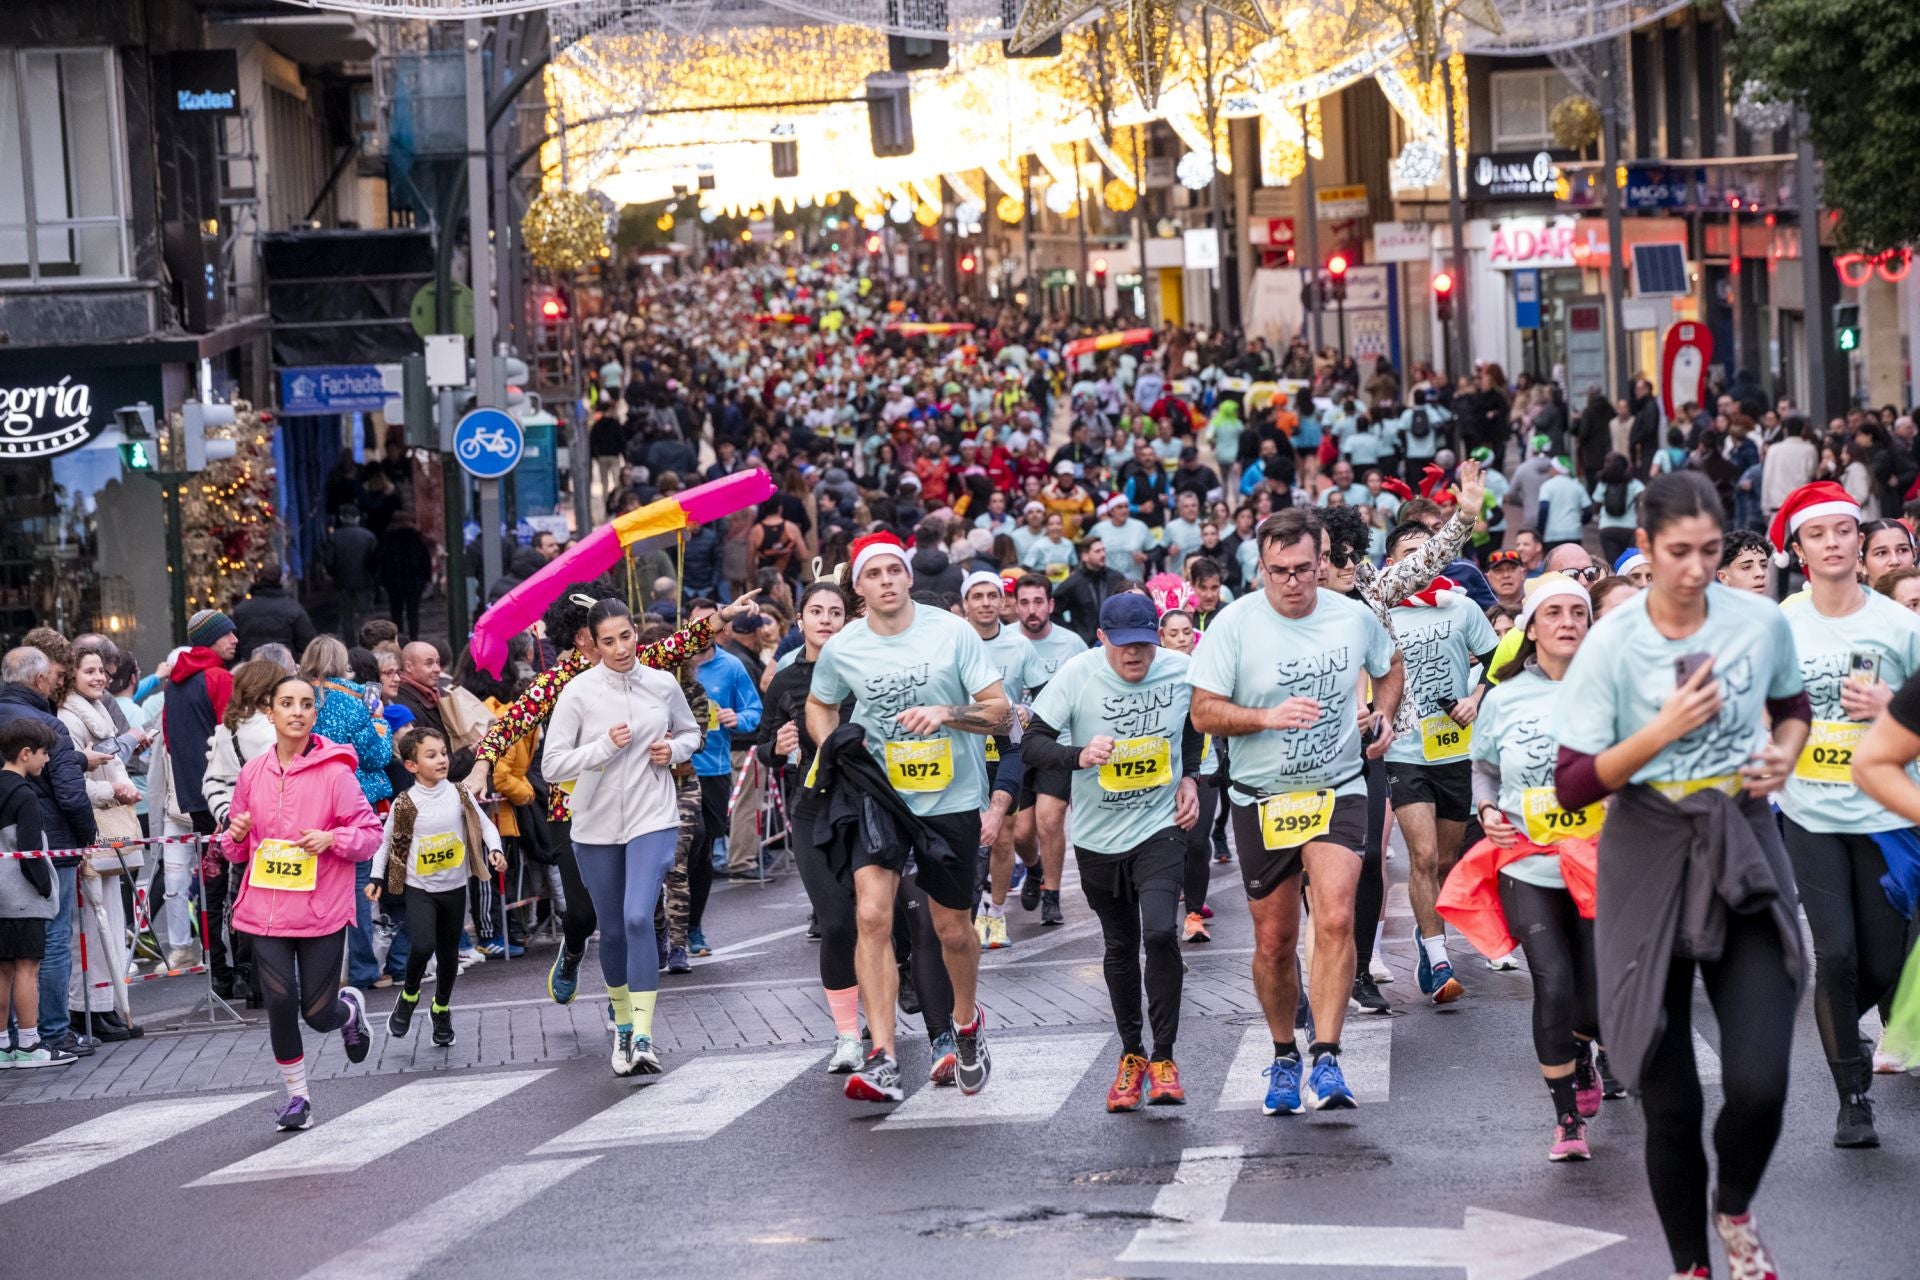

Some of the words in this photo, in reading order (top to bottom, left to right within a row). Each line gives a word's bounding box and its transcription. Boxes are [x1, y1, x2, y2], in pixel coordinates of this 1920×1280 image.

[1489, 226, 1576, 262] ADAR
[0, 424, 87, 454] QUEROS
[1277, 646, 1349, 686] SAN
[865, 662, 928, 700] SAN
[1102, 683, 1174, 720] SAN
[1436, 732, 1460, 746] 168
[1280, 744, 1344, 776] MURCIA
[1812, 748, 1853, 765] 022
[899, 762, 941, 777] 1872
[1113, 759, 1157, 777] 1752
[1274, 814, 1322, 832] 2992
[1545, 809, 1587, 828] 703
[421, 849, 454, 865] 1256
[266, 861, 302, 877] 3123
